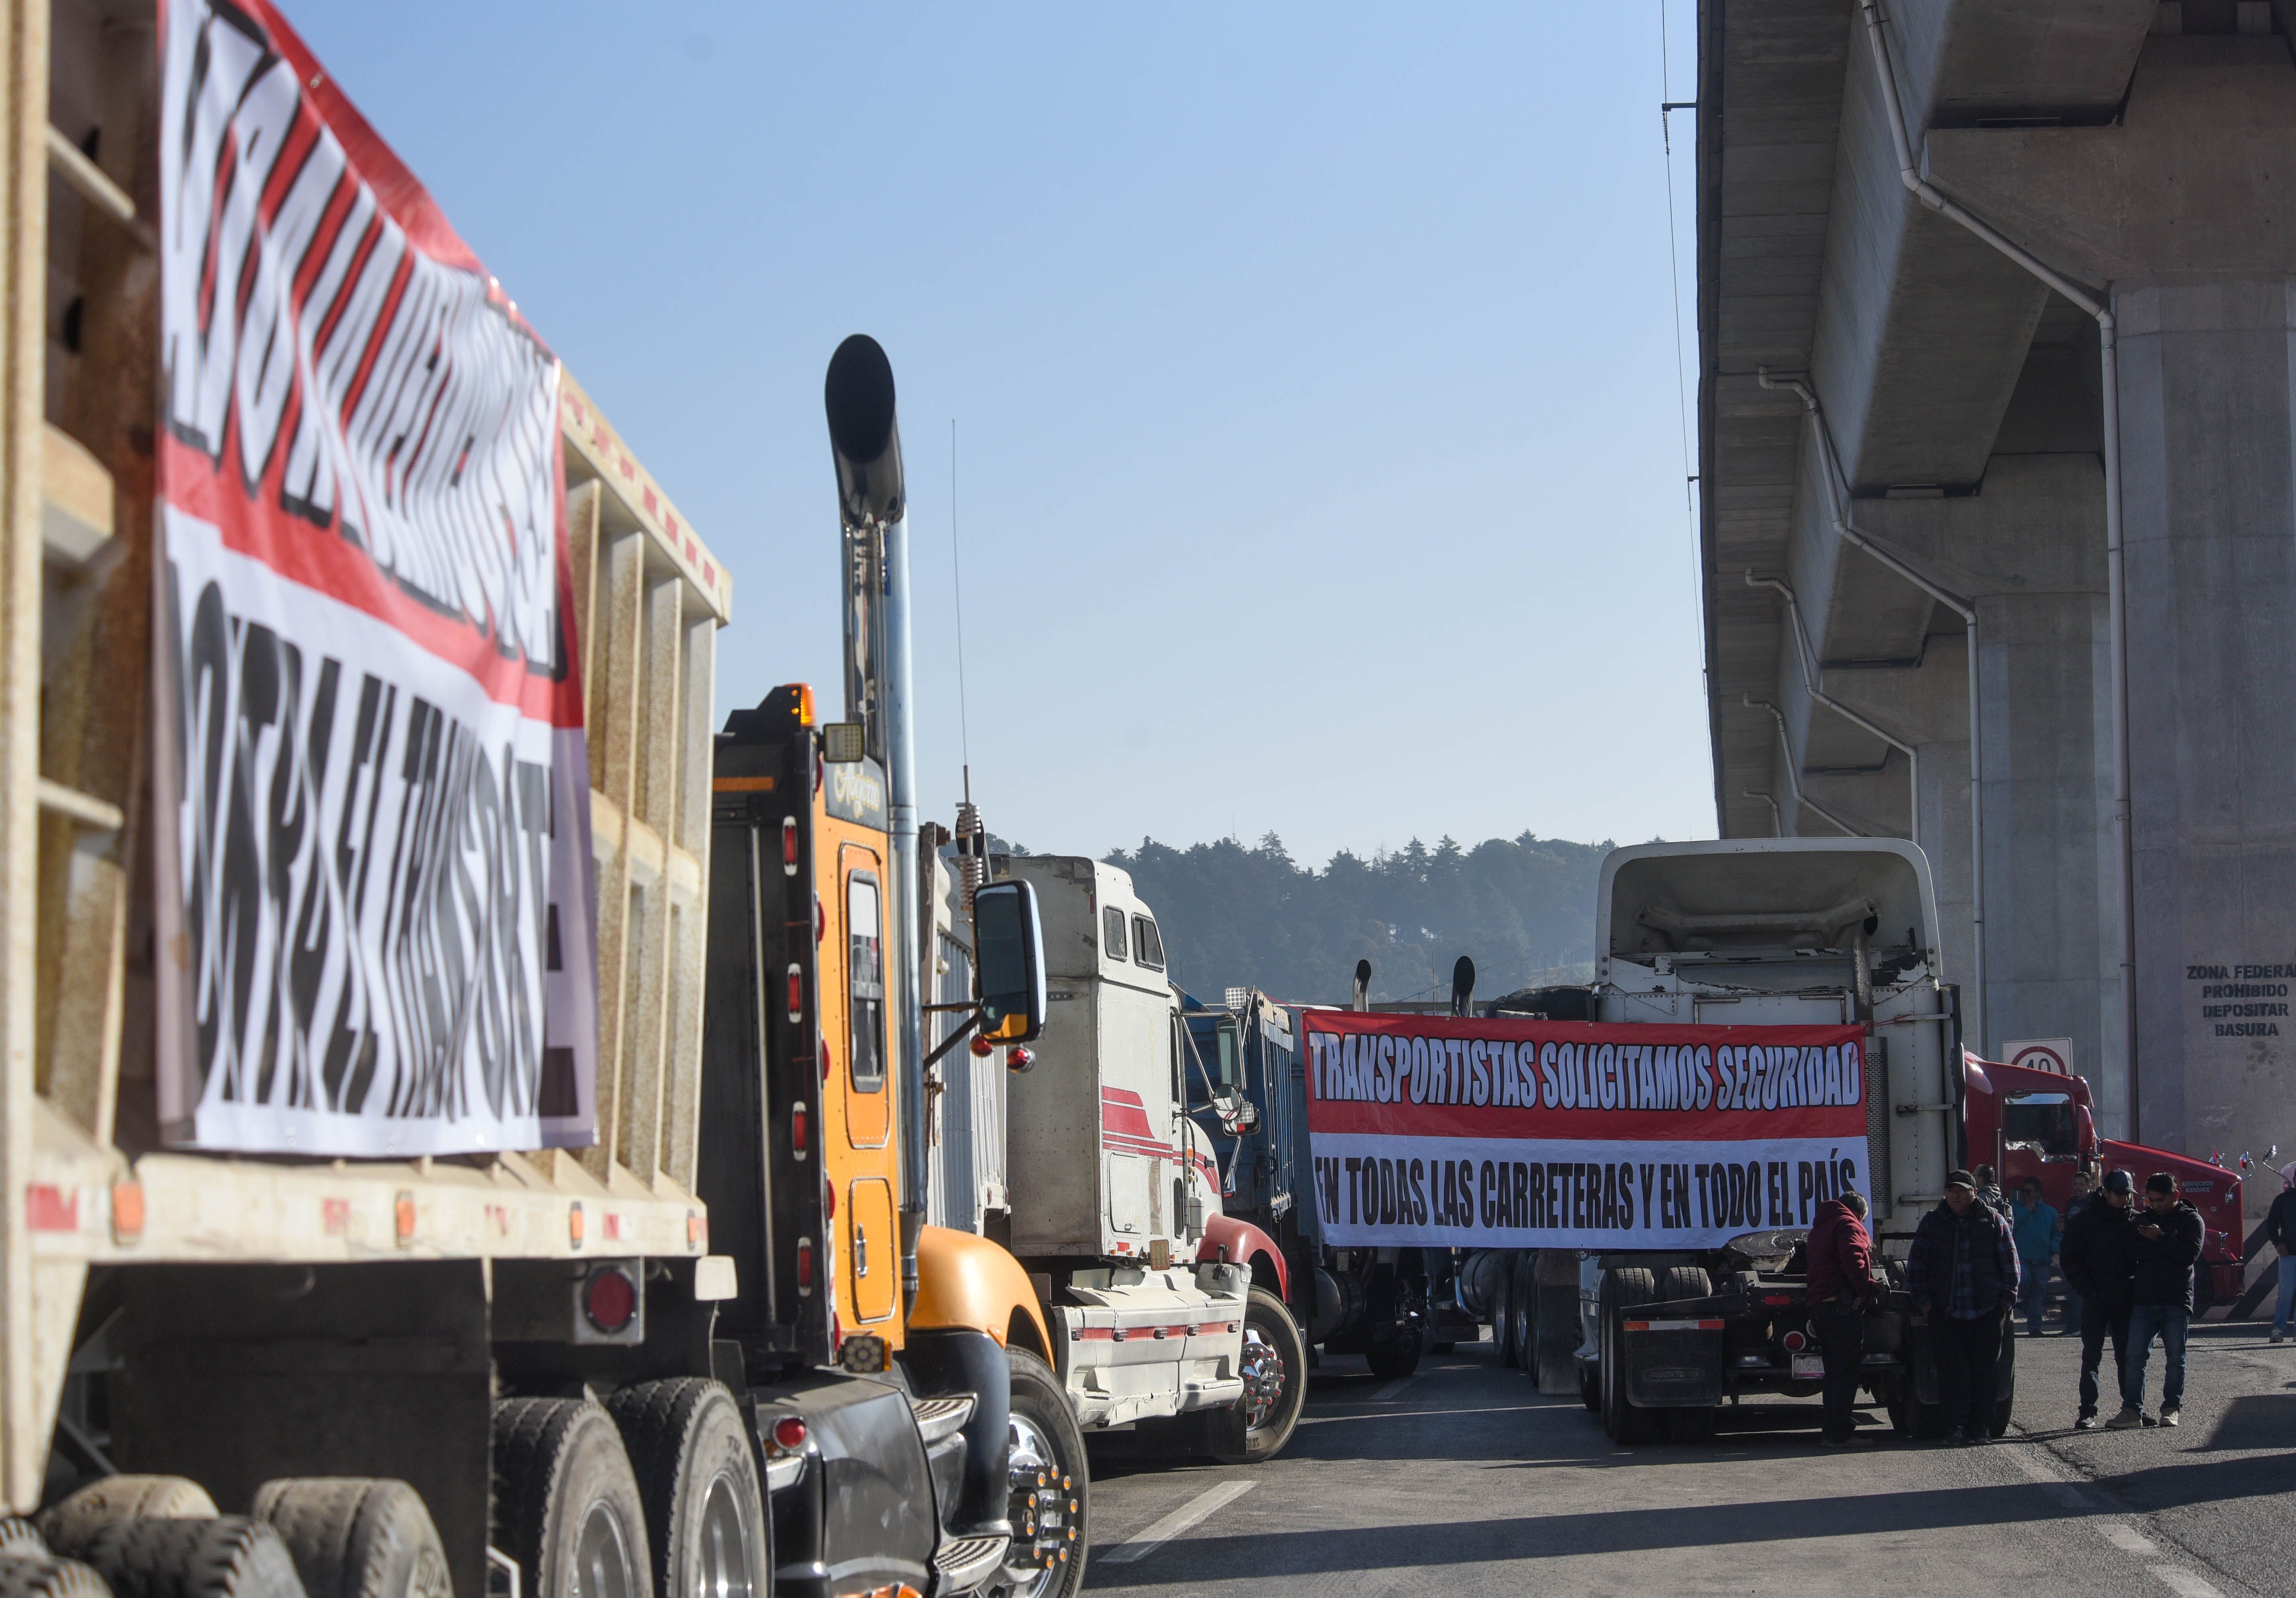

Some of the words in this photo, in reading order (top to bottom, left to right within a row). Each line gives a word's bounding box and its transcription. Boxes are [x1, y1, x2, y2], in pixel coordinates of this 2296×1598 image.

[2186, 966, 2230, 979] ZONA
[2202, 984, 2288, 998] PROHIBIDO
[2202, 1003, 2289, 1018] DEPOSITAR
[2215, 1023, 2279, 1037] BASURA
[1308, 1032, 1538, 1108] TRANSPORTISTAS
[1540, 1042, 1714, 1111] SOLICITAMOS
[1715, 1041, 1861, 1111] SEGURIDAD
[1346, 1156, 1428, 1226] TODAS
[1431, 1159, 1473, 1228] LAS
[1480, 1160, 1633, 1230] CARRETERAS
[1640, 1163, 1653, 1229] Y
[1660, 1163, 1691, 1228] EN
[1695, 1161, 1761, 1228] TODO
[1767, 1161, 1794, 1226] EL
